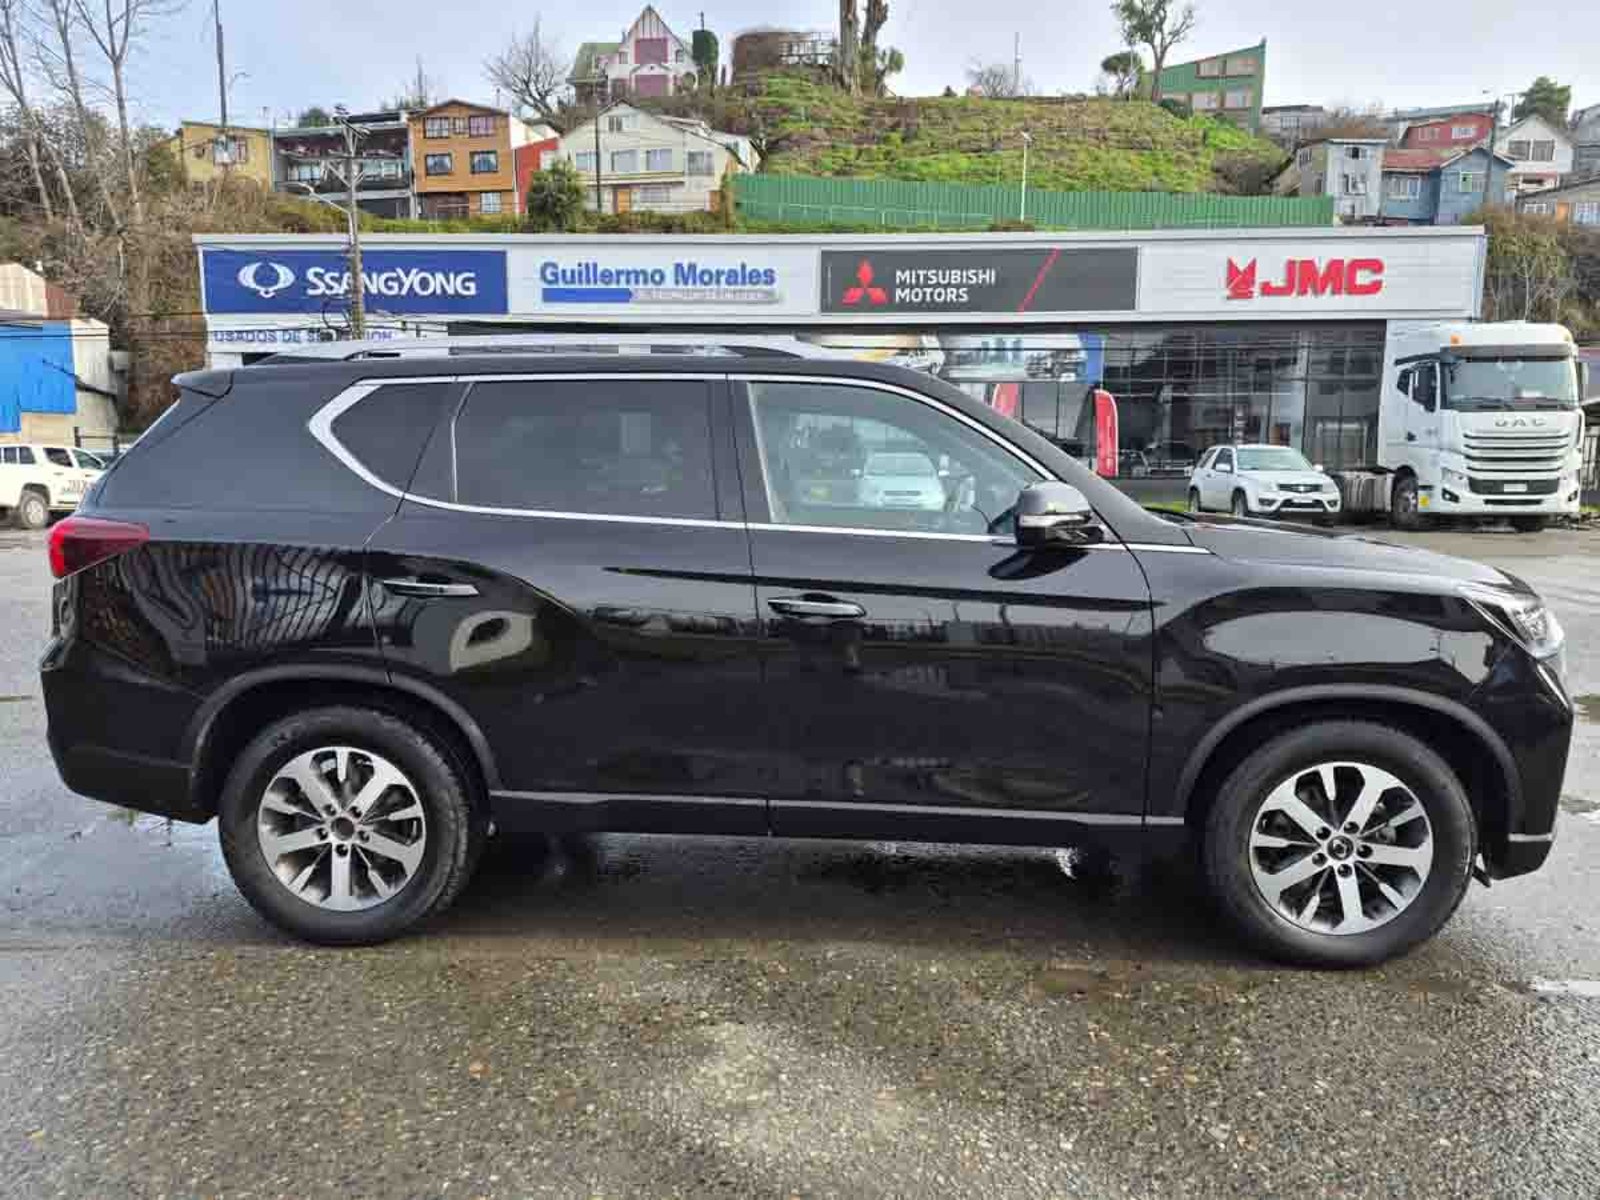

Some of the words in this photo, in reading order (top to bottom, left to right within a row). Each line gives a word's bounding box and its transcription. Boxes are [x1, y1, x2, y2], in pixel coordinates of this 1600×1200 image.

[539, 262, 666, 286] Guillermo
[673, 262, 777, 286] Morales
[895, 269, 996, 285] MITSUBISHI
[1259, 258, 1385, 297] JMC
[895, 287, 969, 302] MOTORS
[213, 330, 278, 343] USADOS
[282, 330, 301, 343] DE
